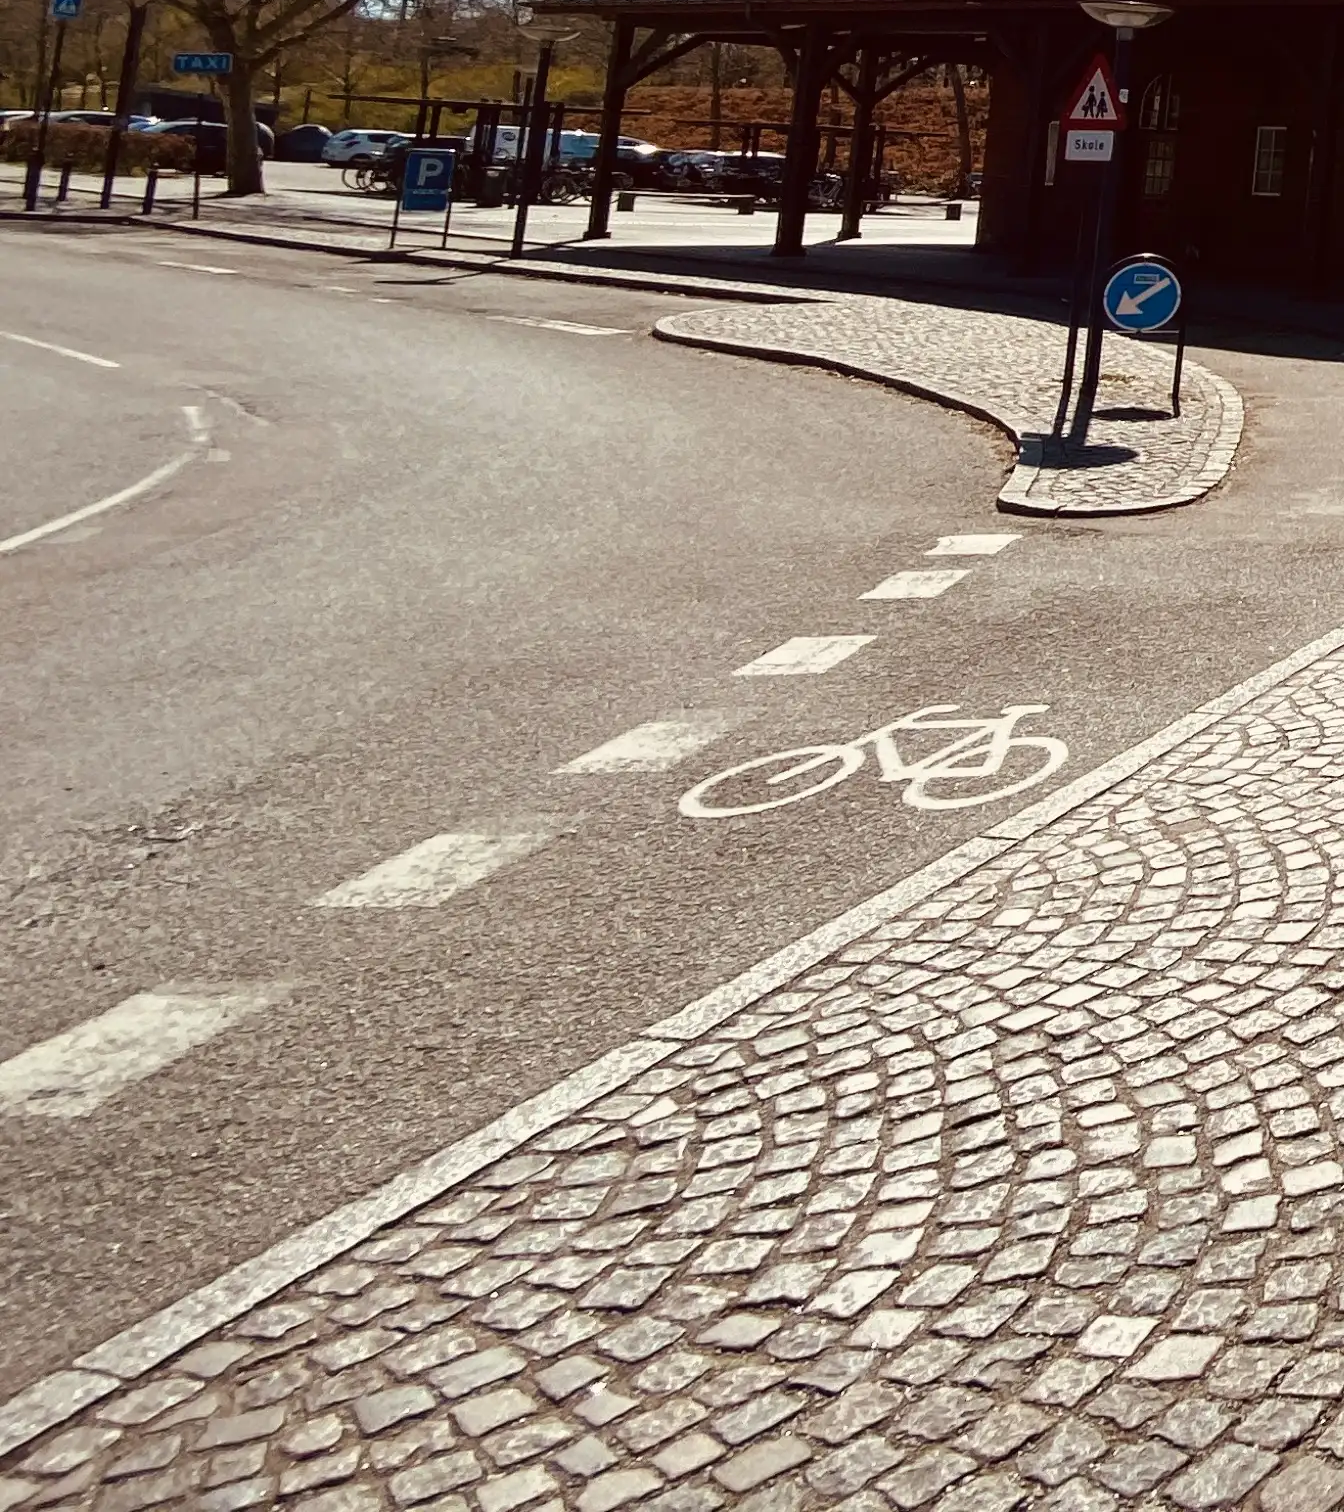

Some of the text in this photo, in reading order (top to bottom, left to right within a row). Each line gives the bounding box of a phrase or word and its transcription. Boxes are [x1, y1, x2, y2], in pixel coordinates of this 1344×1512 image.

[177, 55, 227, 69] TAXI
[1074, 139, 1105, 152] Skole
[417, 157, 444, 186] P
